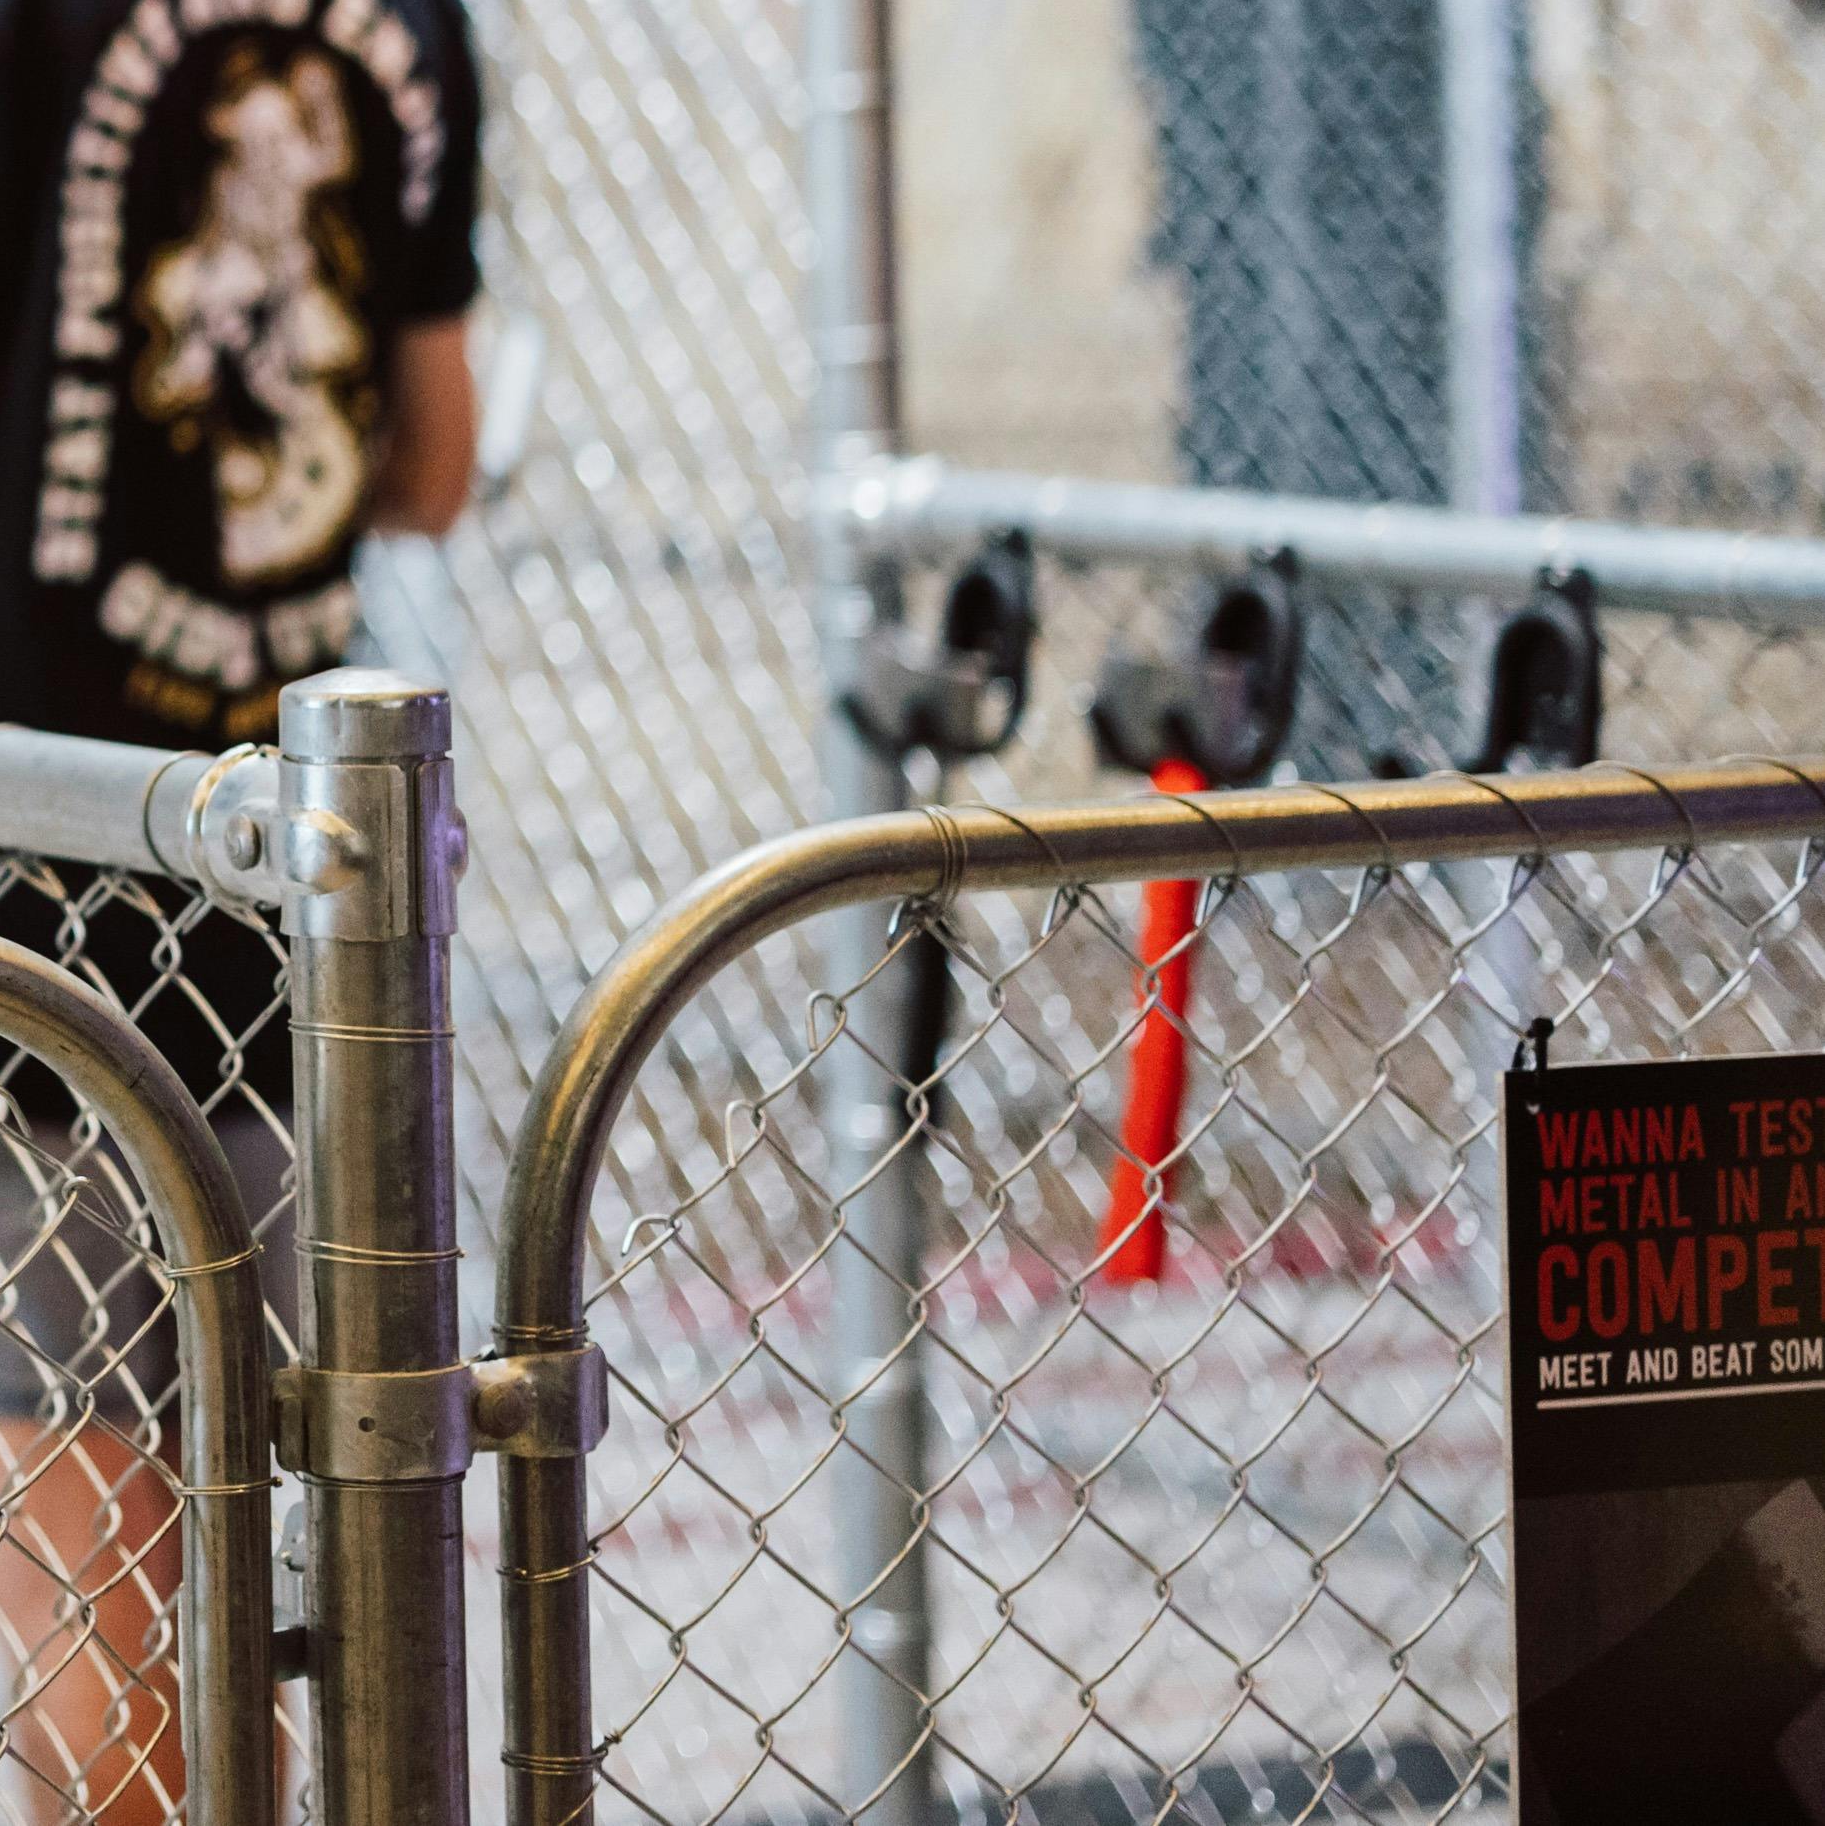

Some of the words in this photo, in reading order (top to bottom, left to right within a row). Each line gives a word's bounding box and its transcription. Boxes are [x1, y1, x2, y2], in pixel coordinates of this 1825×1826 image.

[1537, 1104, 1706, 1170] WANNA
[1540, 1171, 1692, 1236] METAL
[1717, 1166, 1760, 1225] IN
[1539, 1351, 1613, 1391] MEET
[1626, 1347, 1678, 1384] AND
[1692, 1341, 1757, 1380] BEAT
